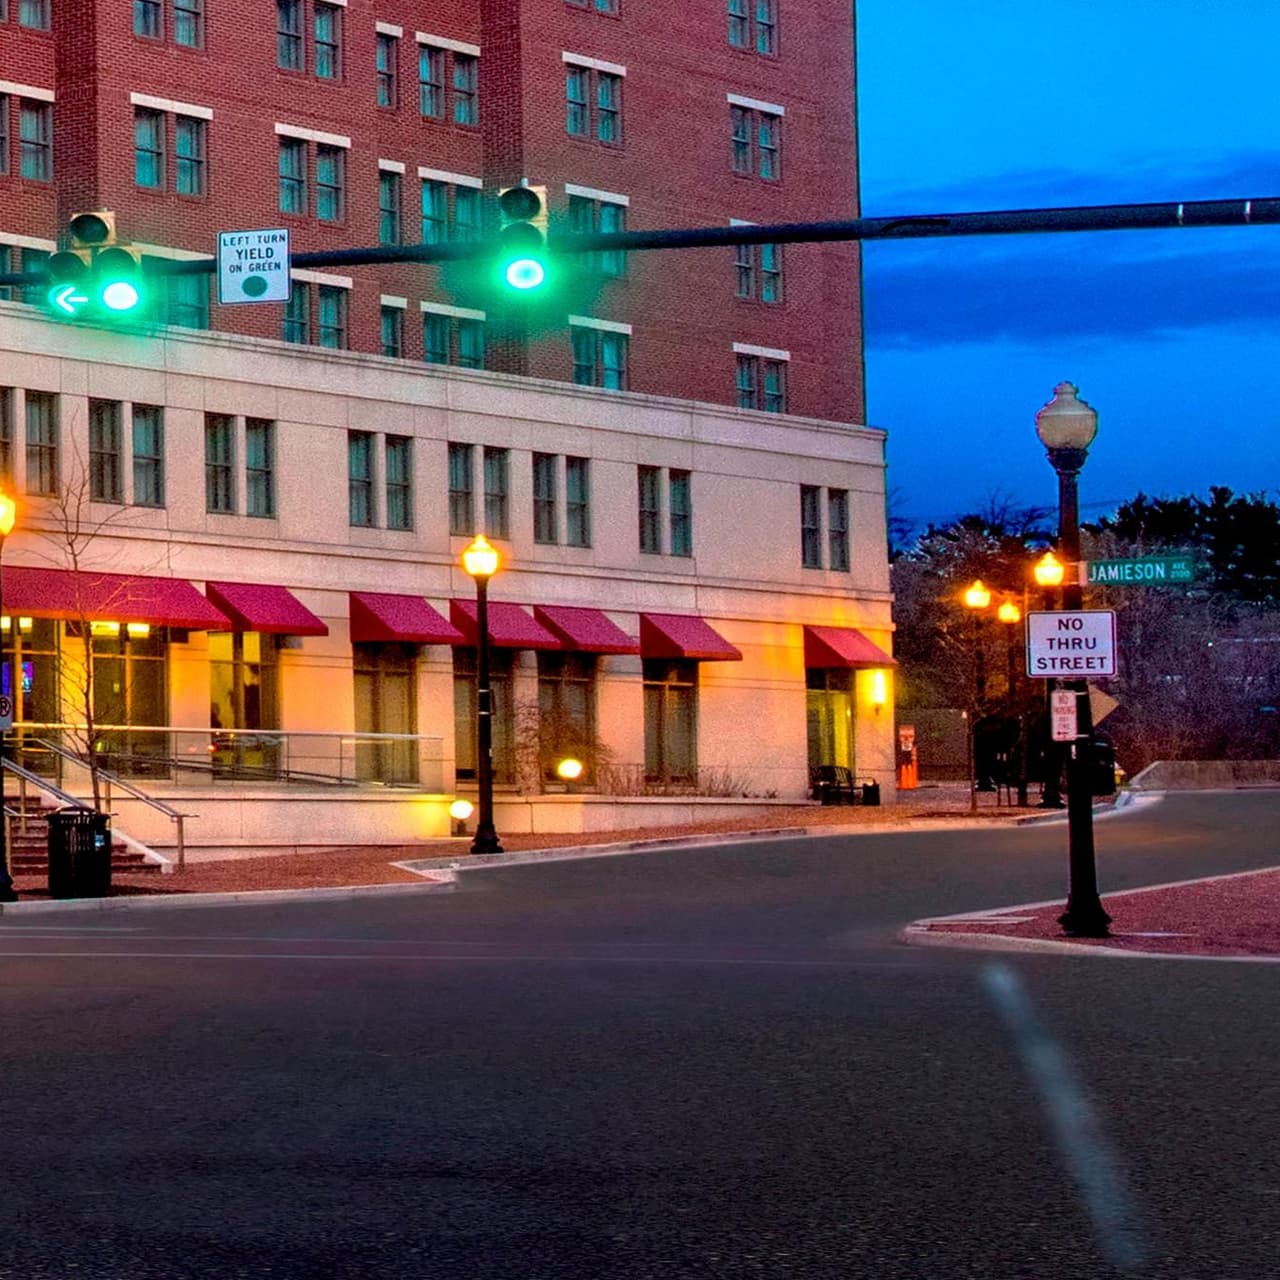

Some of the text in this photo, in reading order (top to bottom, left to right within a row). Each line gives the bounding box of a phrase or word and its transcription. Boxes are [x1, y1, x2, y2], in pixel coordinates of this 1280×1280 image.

[223, 233, 286, 247] LEFT TURN
[236, 247, 274, 260] YIELD
[228, 261, 282, 274] ON GREEN
[1088, 562, 1166, 582] JAMIESON
[1057, 618, 1084, 631] NO
[1046, 637, 1097, 650] THRU
[1036, 656, 1107, 670] STREET
